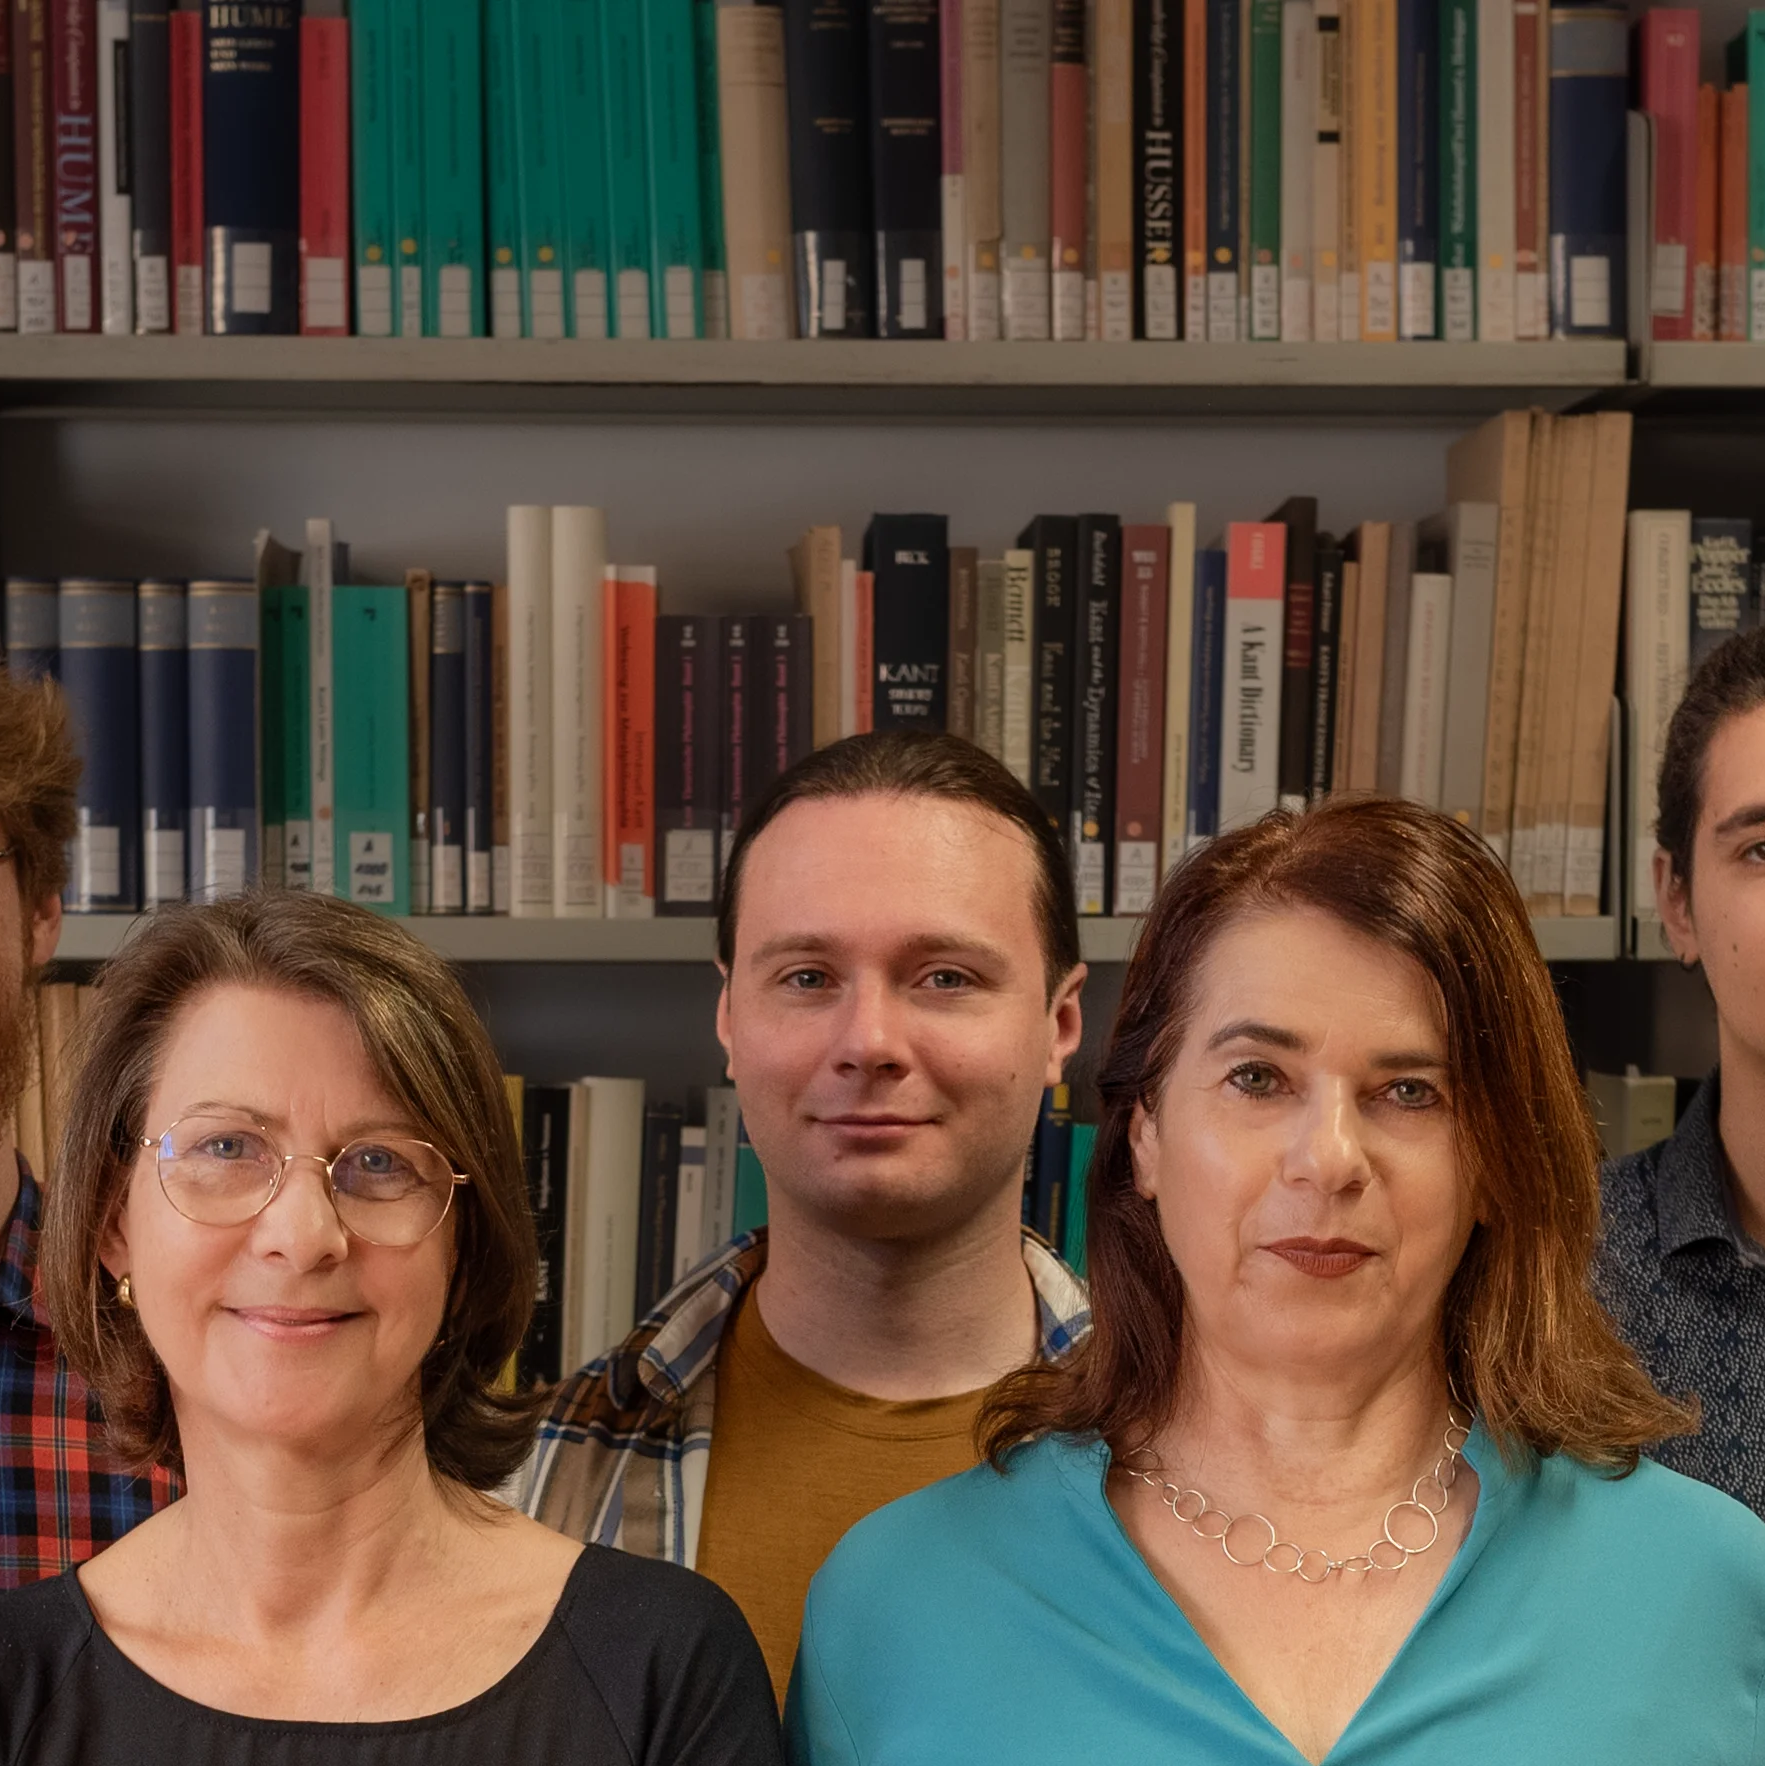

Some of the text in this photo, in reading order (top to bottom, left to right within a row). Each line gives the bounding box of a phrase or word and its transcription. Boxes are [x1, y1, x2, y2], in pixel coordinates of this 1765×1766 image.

[209, 4, 293, 29] HUME
[57, 112, 94, 256] HUME
[1144, 131, 1173, 267] HUSSER
[1005, 566, 1030, 644] Bennett
[1087, 599, 1108, 644] Kant
[615, 626, 632, 689] Vorlesung
[878, 663, 941, 683] KANT
[1042, 681, 1060, 712] and
[1081, 686, 1106, 774] Dynamics
[1231, 622, 1267, 774] A Kant Dictionary
[616, 717, 632, 829] Moralphilosophie
[1040, 744, 1062, 786] Mind
